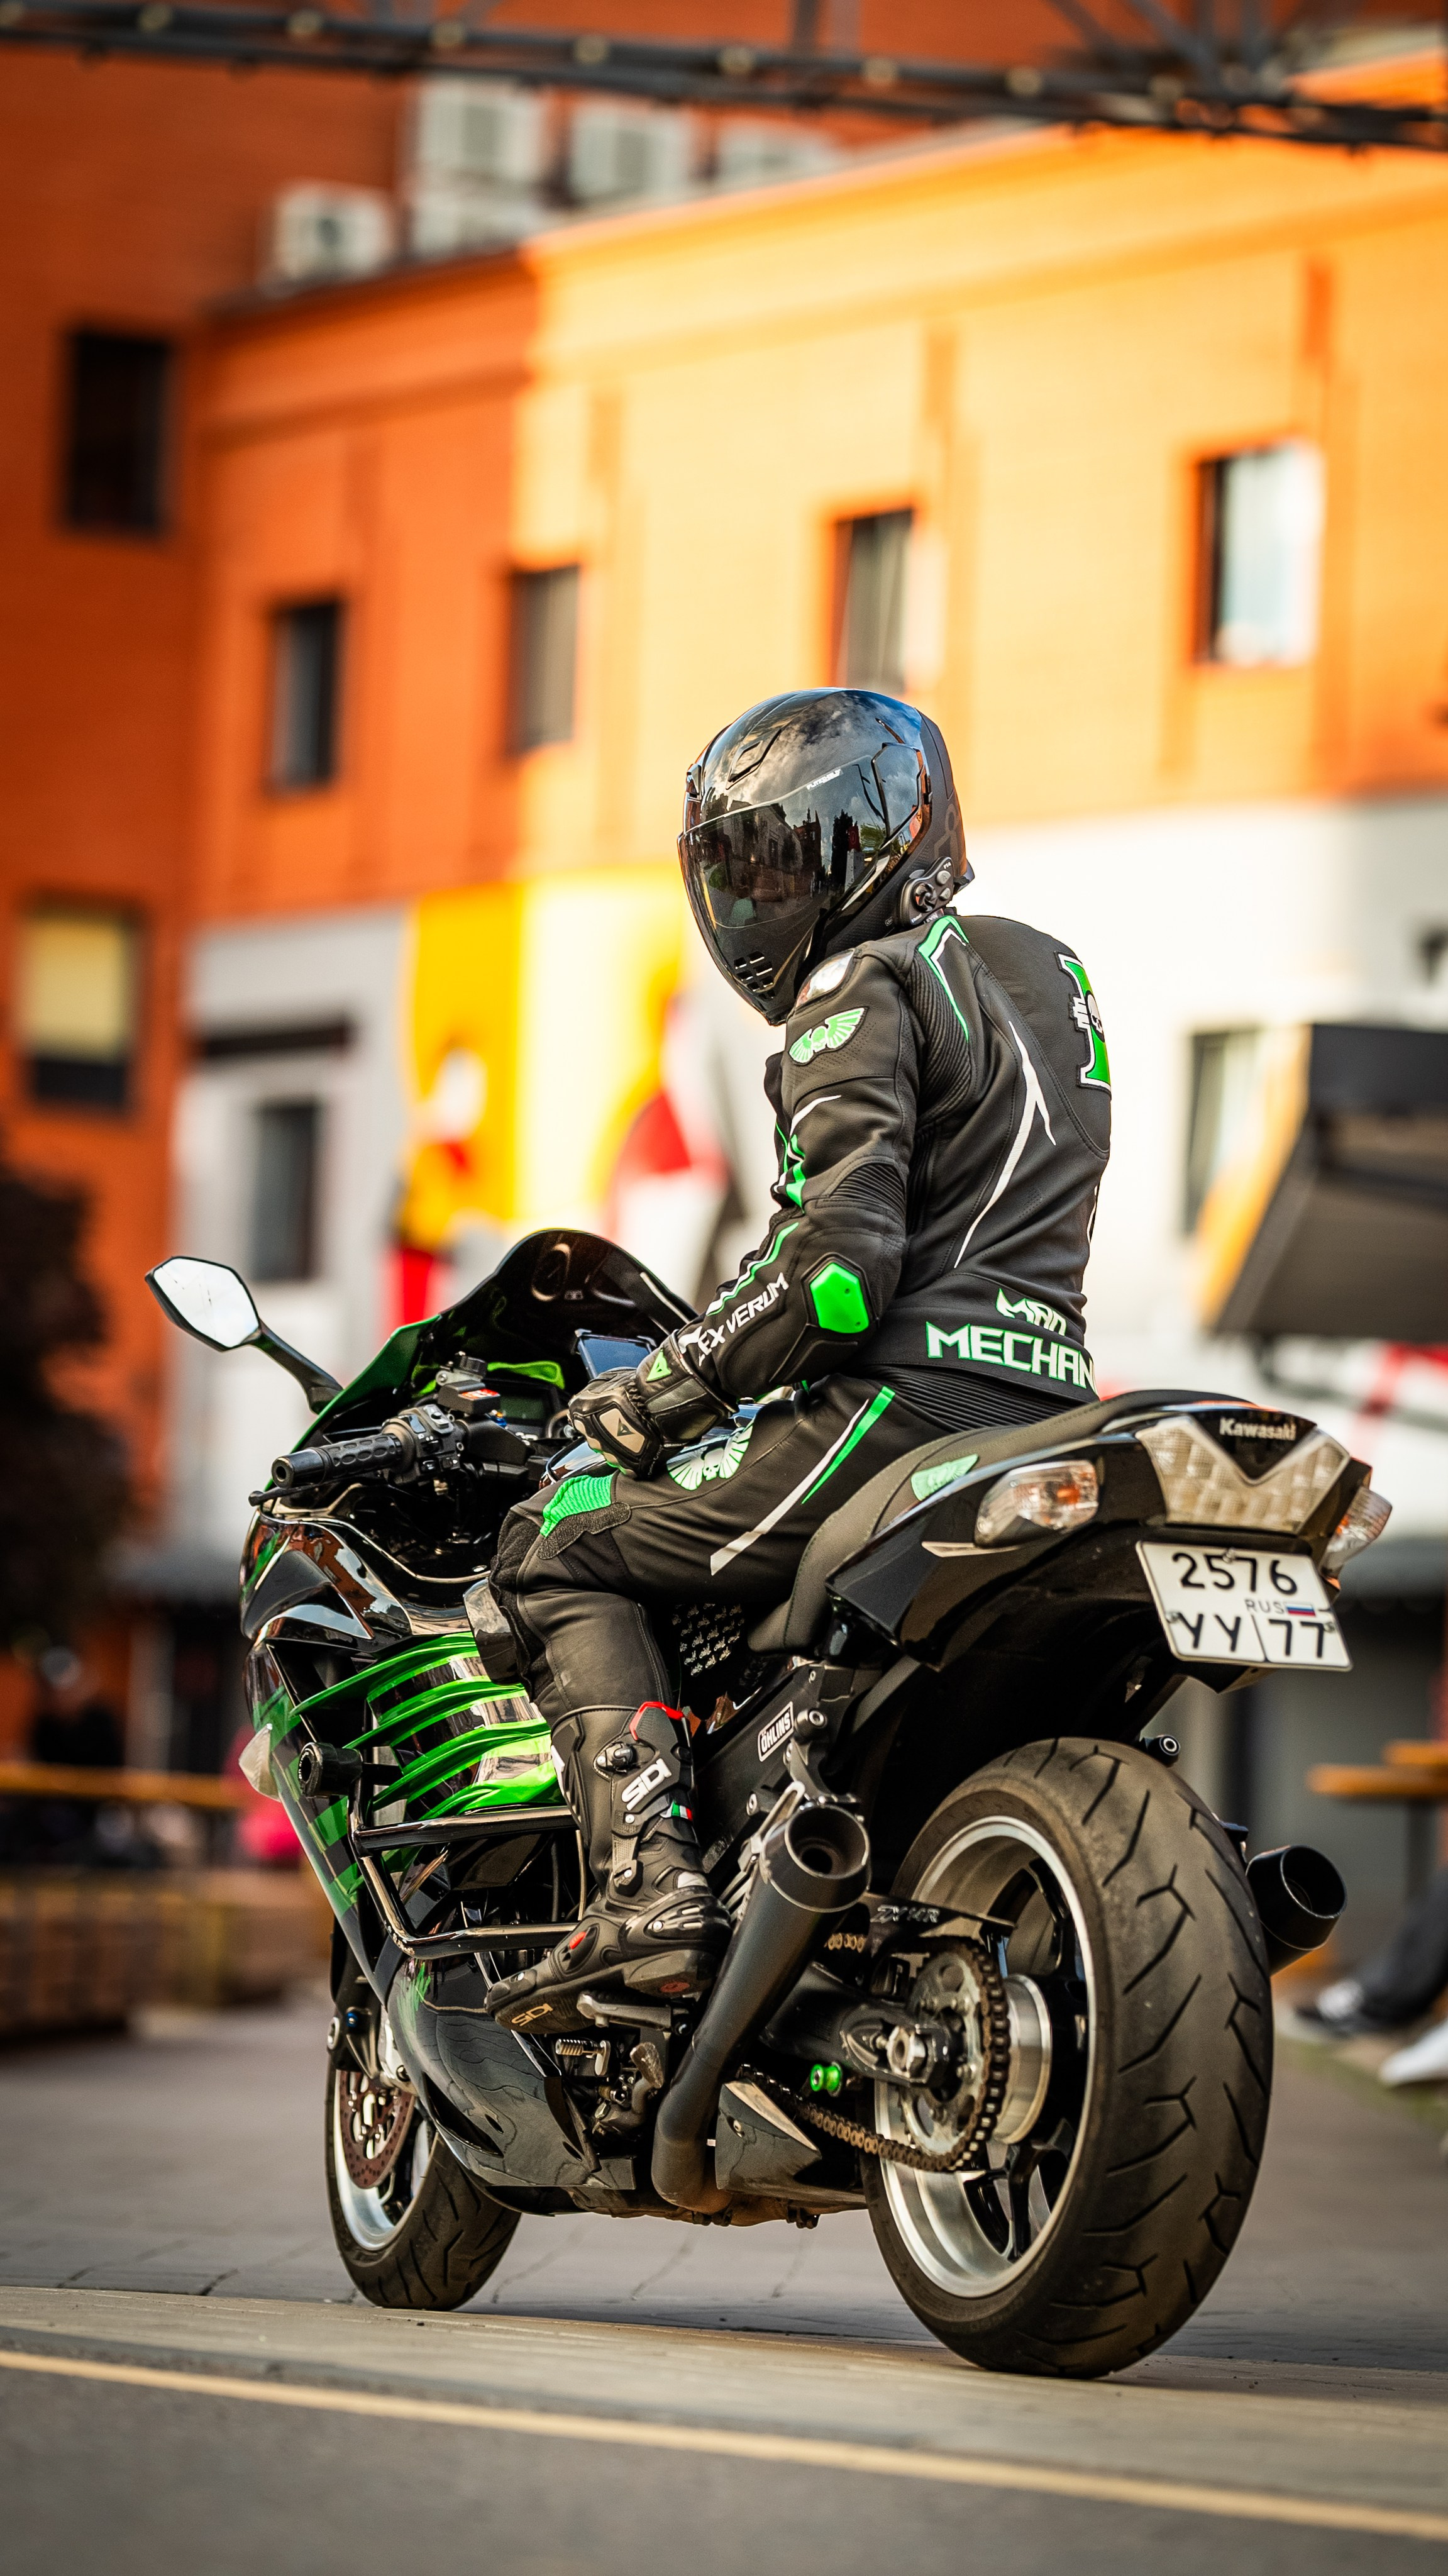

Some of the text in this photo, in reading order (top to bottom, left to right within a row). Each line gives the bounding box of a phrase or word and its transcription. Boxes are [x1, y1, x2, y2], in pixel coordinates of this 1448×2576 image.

[726, 1272, 789, 1334] VERUM
[1219, 1416, 1296, 1441] Kawasaki
[1172, 1552, 1298, 1596] 2576
[1245, 1599, 1285, 1614] RUS
[1268, 1619, 1324, 1658] 77
[761, 1711, 791, 1753] ÖHLINS
